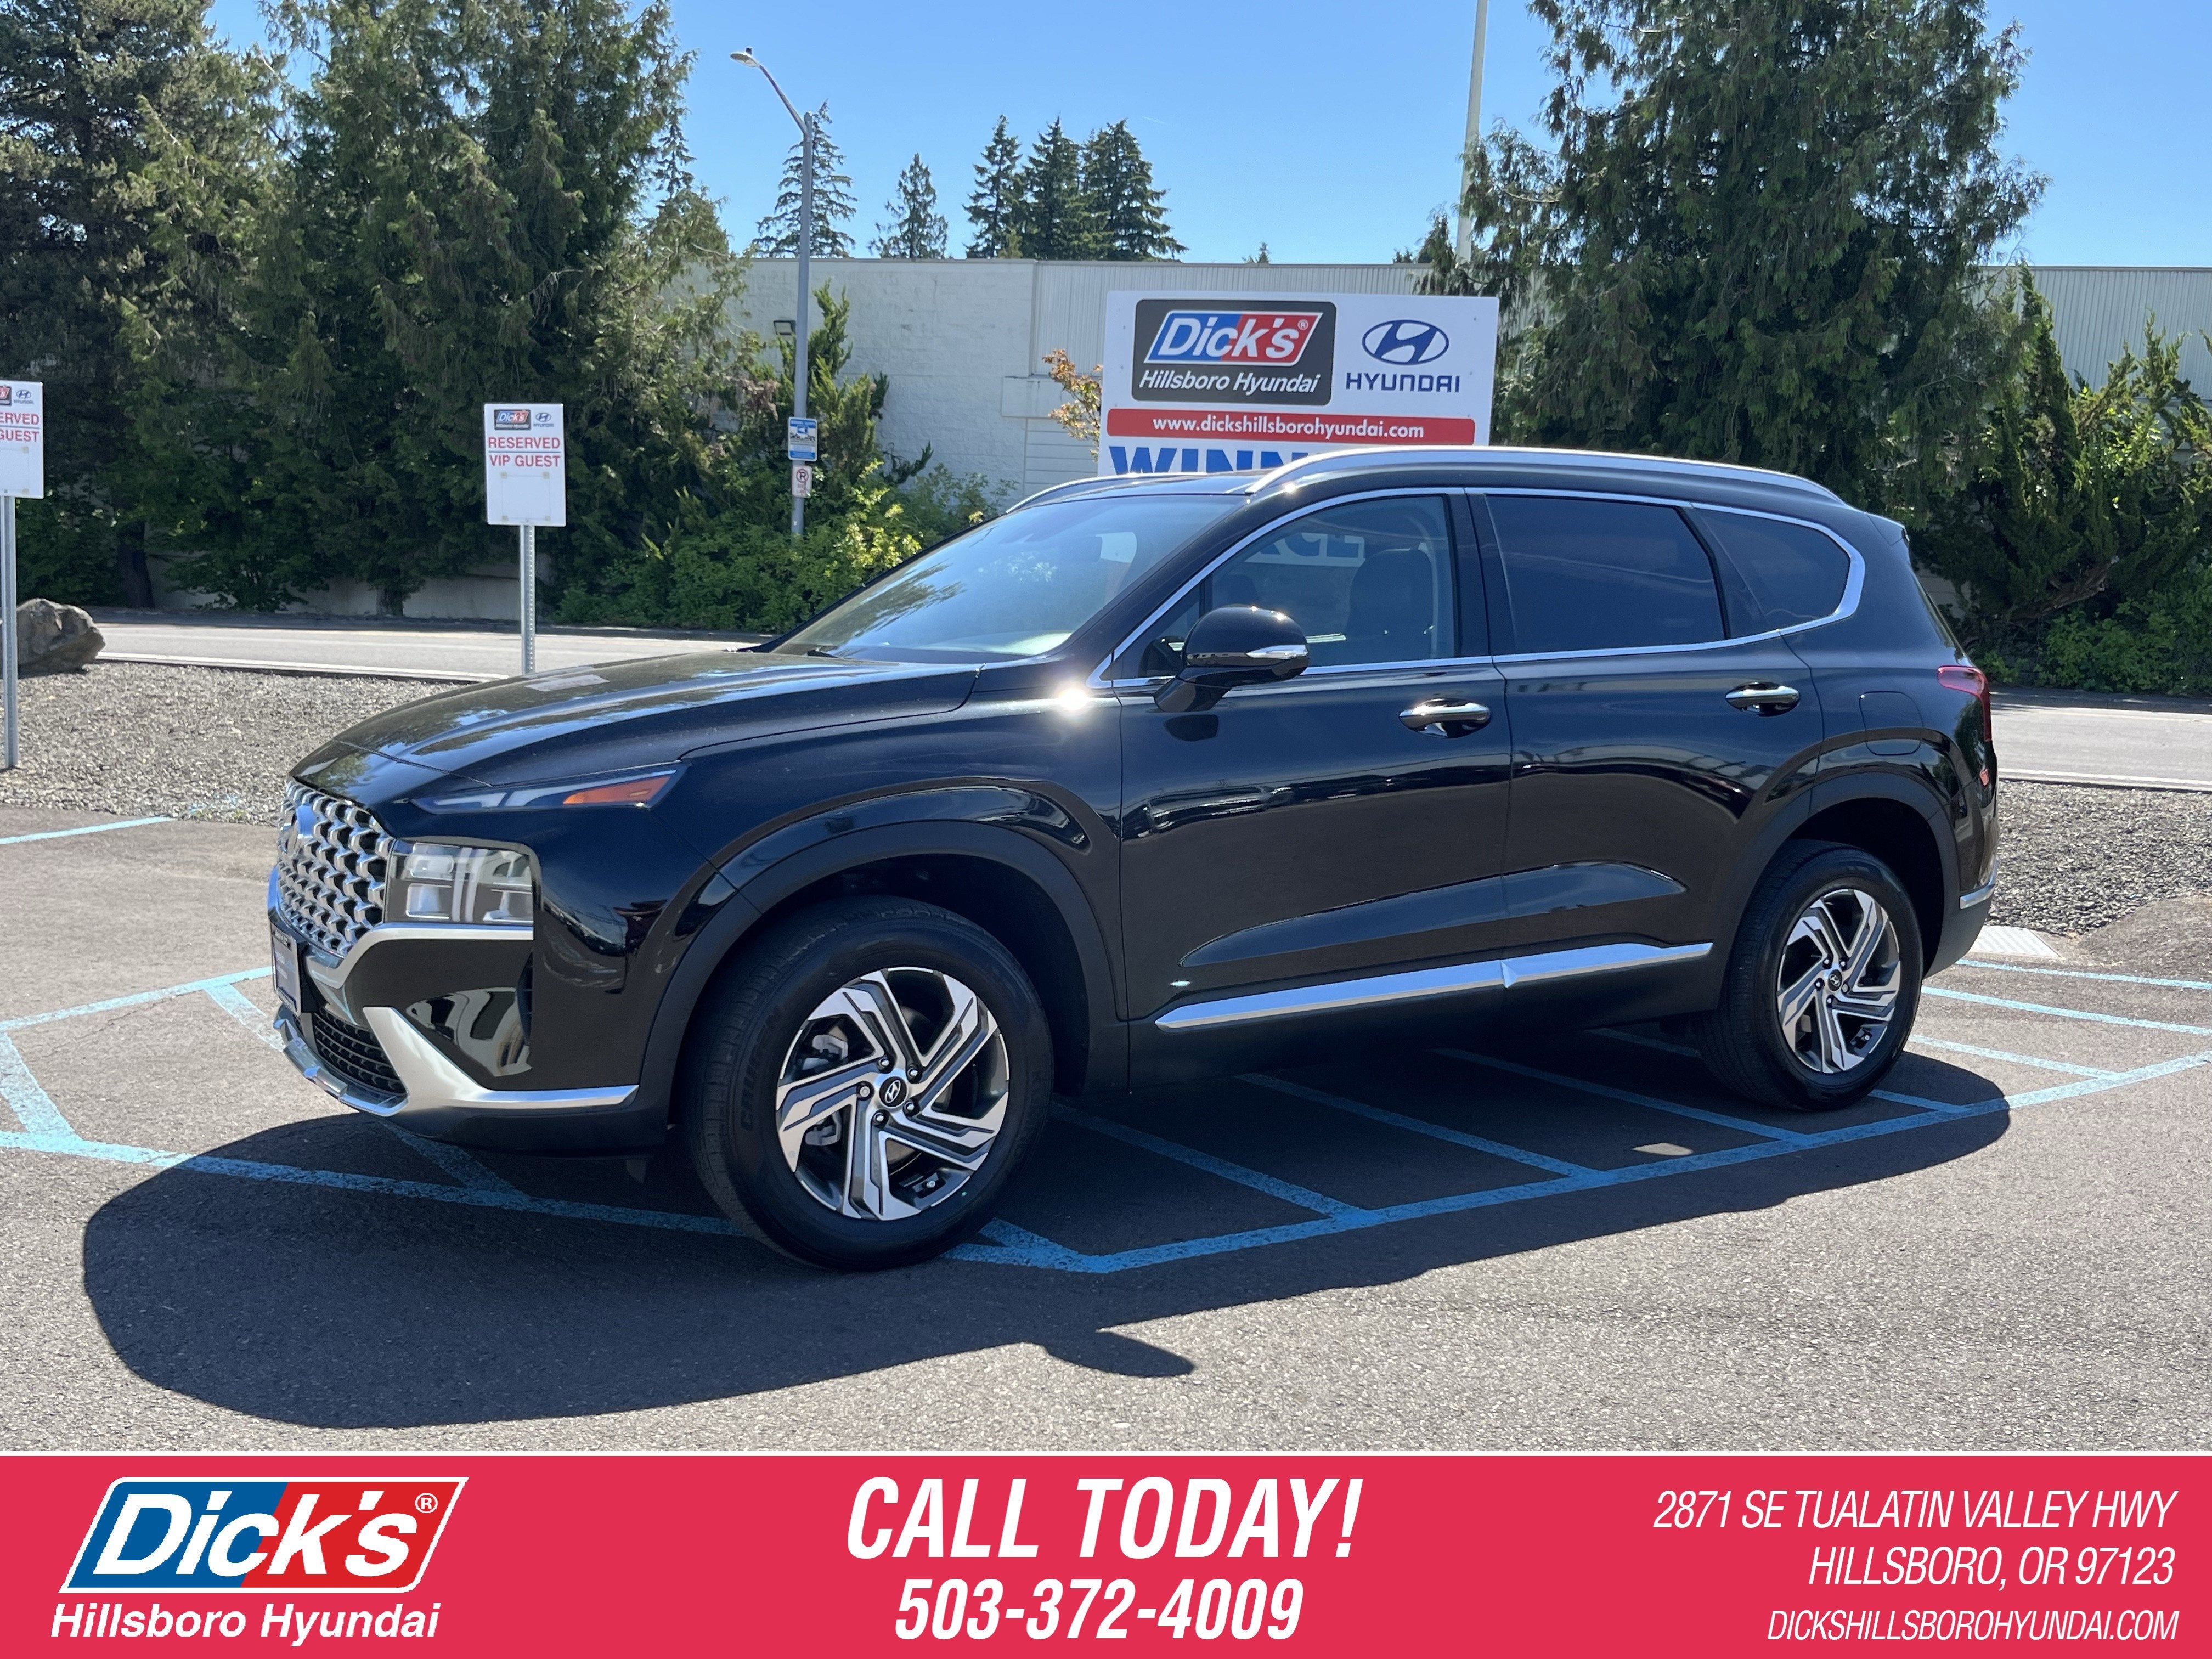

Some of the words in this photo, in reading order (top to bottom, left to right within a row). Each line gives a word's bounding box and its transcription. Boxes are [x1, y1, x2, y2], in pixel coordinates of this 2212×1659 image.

[1158, 317, 1299, 358] Dick's
[1139, 370, 1231, 390] Hillsboro
[1233, 372, 1321, 396] Hyundai
[1346, 373, 1460, 393] HYUNDAI
[1153, 414, 1424, 440] www.dickshillsborohyundai.com
[488, 437, 561, 449] RESERVED
[489, 455, 511, 466] VIP
[515, 455, 561, 467] GUEST
